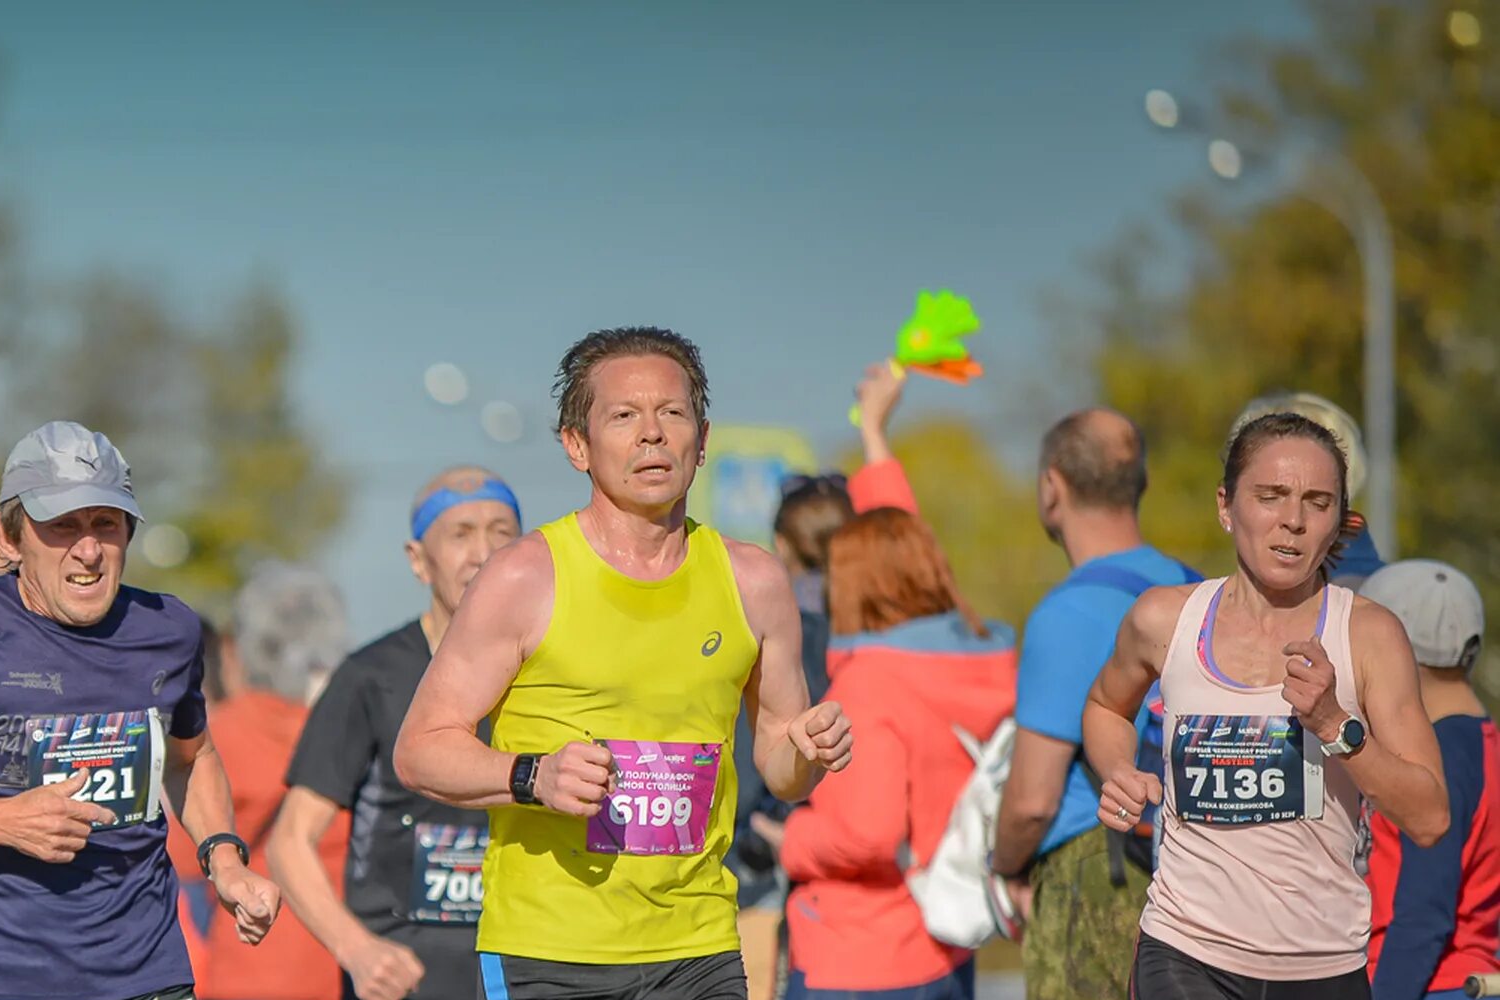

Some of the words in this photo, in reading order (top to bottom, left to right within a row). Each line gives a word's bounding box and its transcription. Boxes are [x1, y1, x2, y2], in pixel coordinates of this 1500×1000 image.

[625, 771, 695, 781] ПОЛУМАРАФОН
[1211, 758, 1256, 766] MASTERS
[1185, 766, 1285, 799] 7136
[609, 794, 692, 827] 6199
[425, 870, 485, 902] 700
